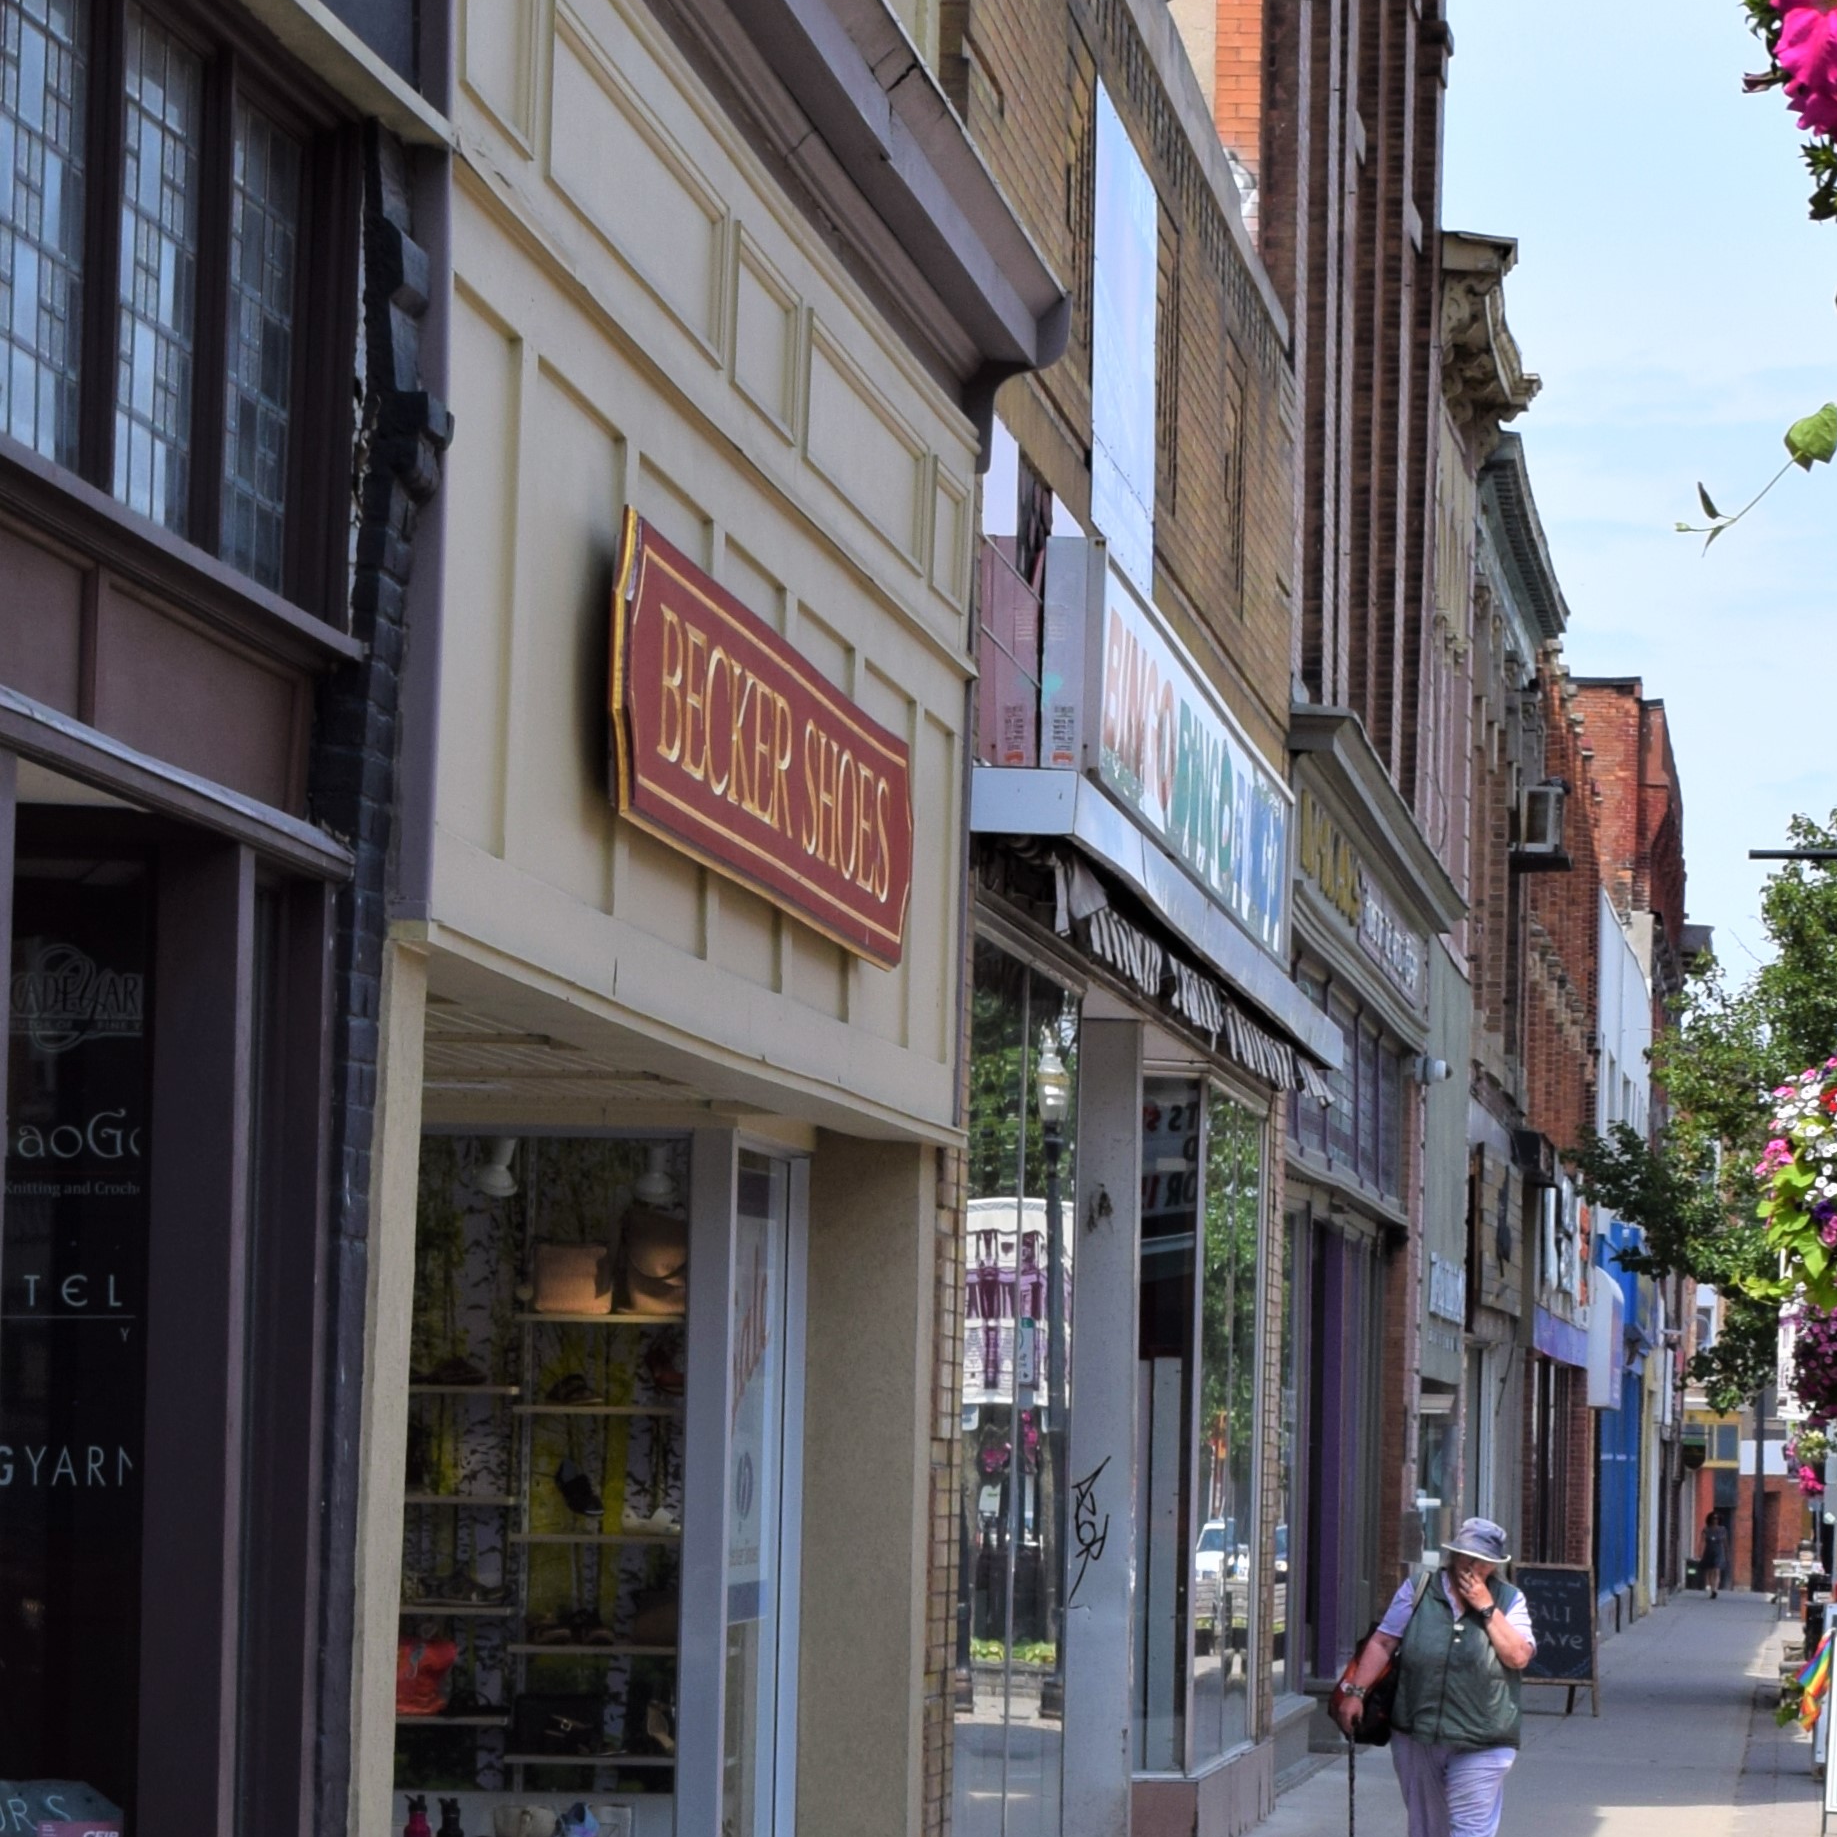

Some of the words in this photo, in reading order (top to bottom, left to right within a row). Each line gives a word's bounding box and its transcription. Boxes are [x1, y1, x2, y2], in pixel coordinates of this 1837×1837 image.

[656, 602, 794, 838] BECKER
[802, 718, 890, 903] SHOES
[64, 1180, 91, 1195] and
[1528, 1602, 1572, 1623] SALT
